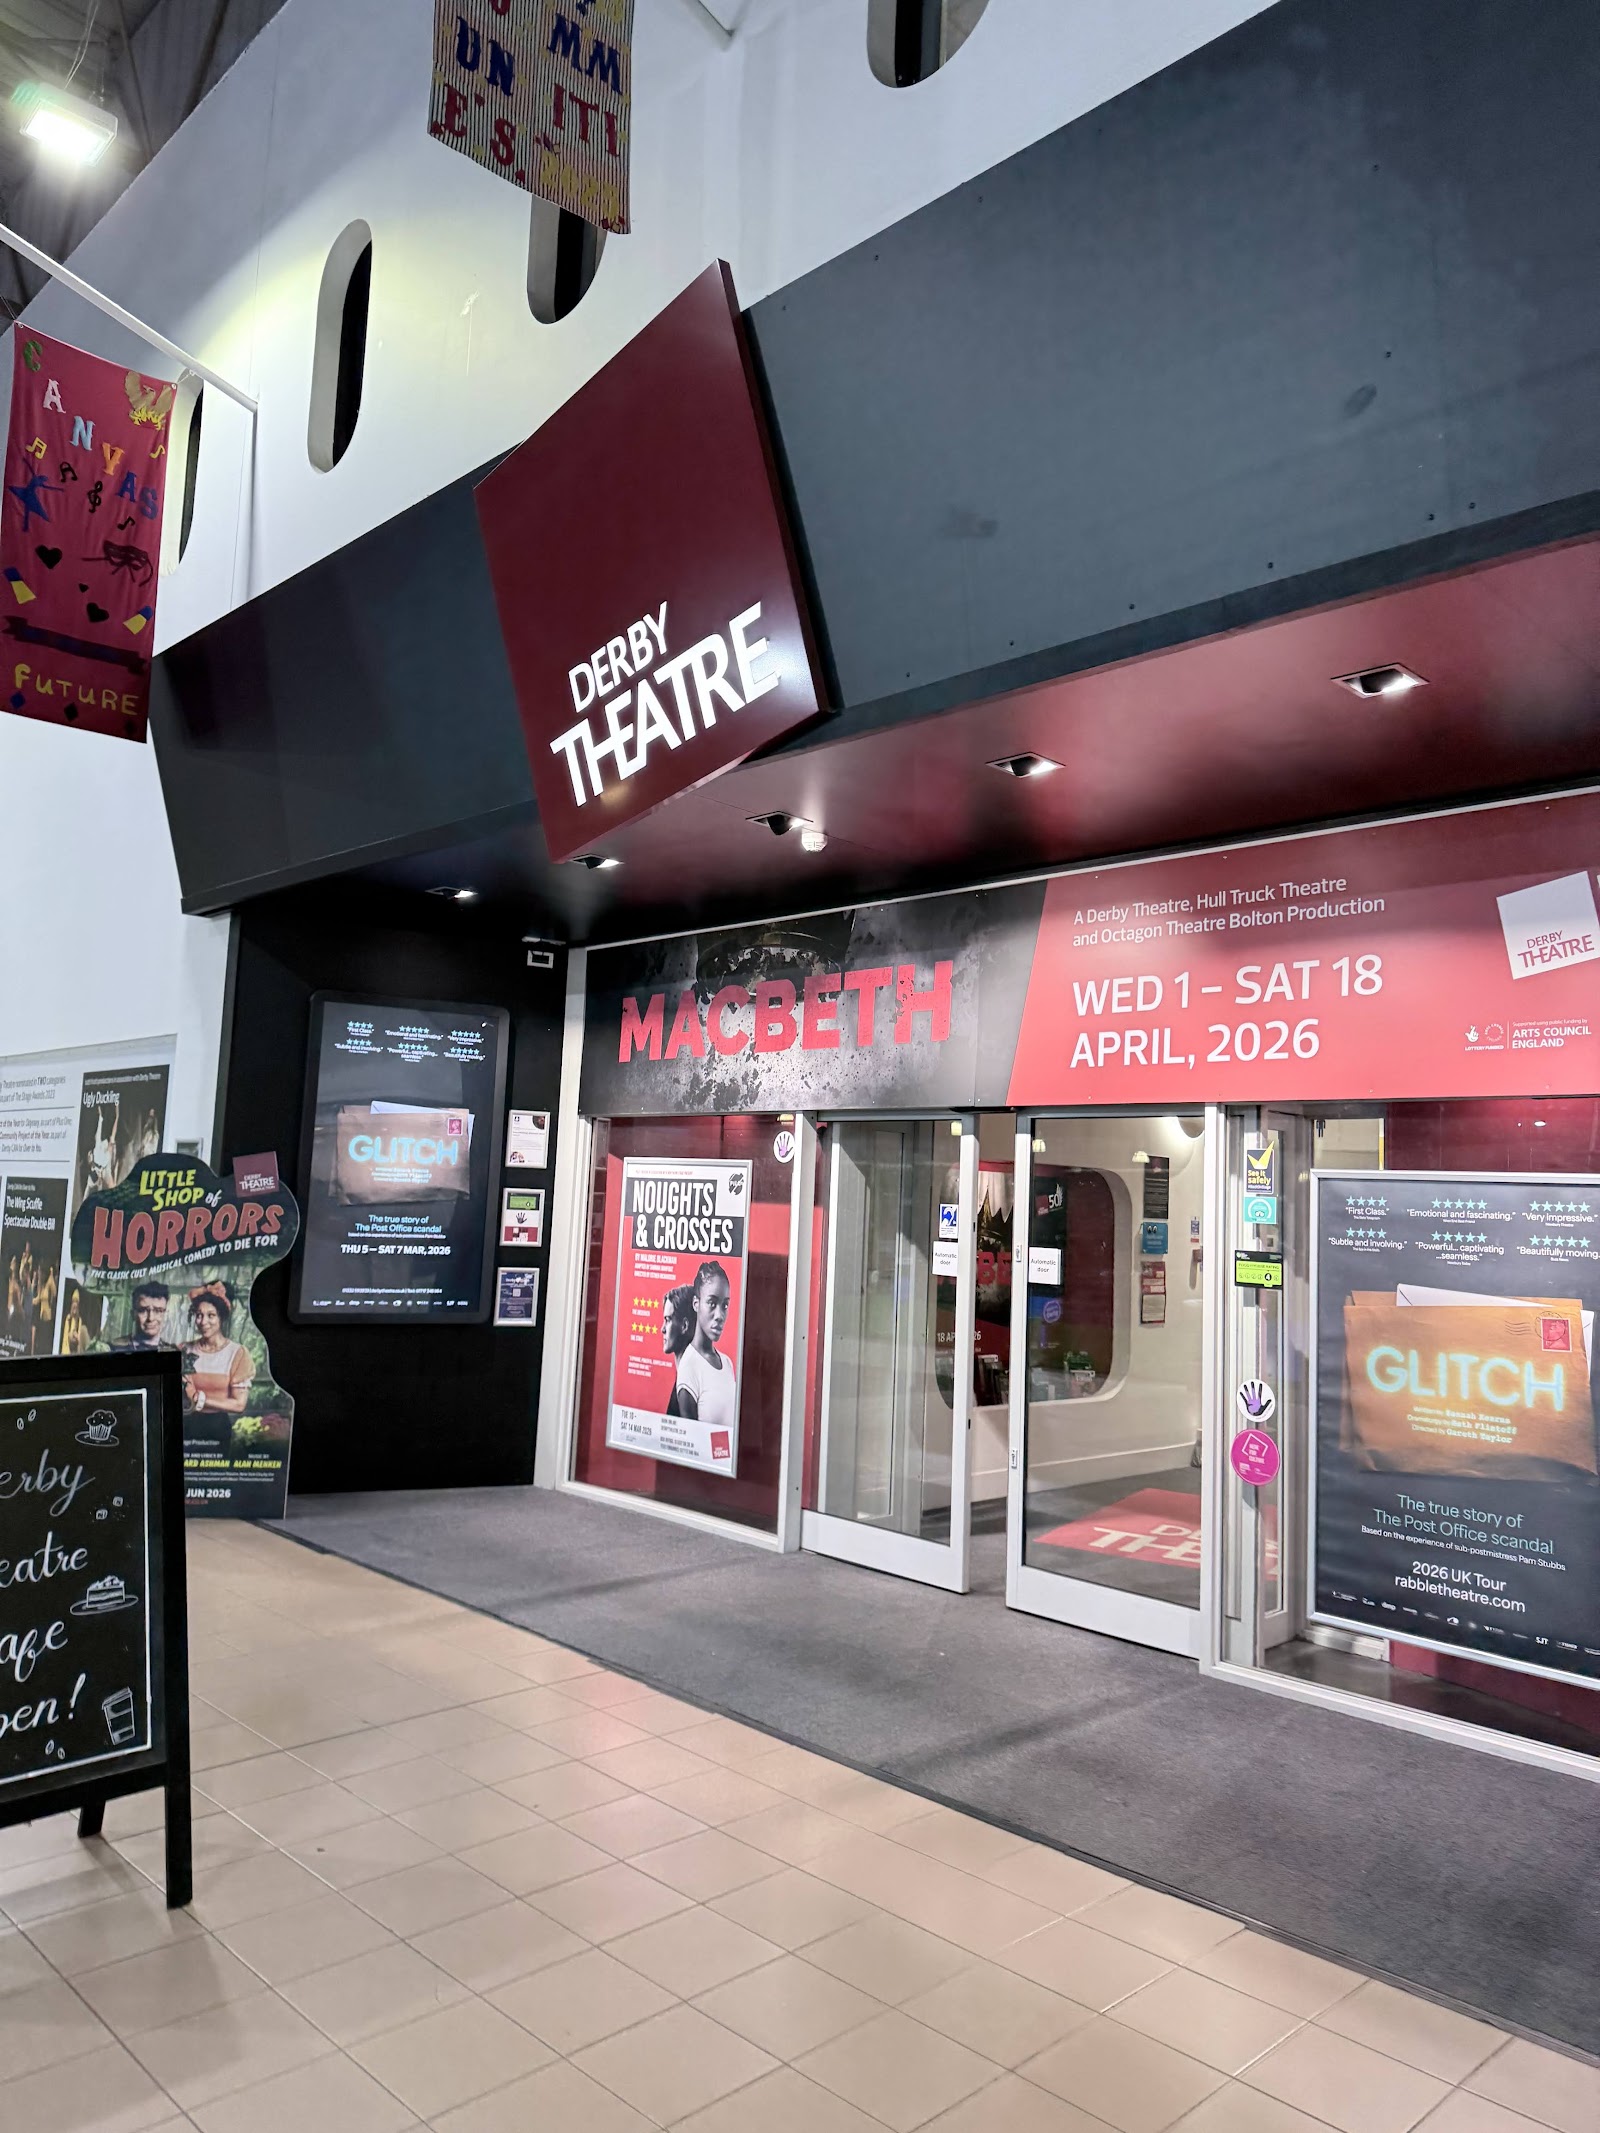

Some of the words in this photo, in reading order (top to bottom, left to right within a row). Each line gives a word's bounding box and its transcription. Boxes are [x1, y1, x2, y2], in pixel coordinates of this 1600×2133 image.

[568, 600, 667, 713] DERBY
[14, 663, 139, 716] FUTURE
[550, 600, 781, 807] THEATRE
[1073, 910, 1084, 926] A
[1087, 905, 1129, 924] Derby
[1132, 898, 1194, 919] Theatre,
[1196, 890, 1227, 910] Hull
[1230, 885, 1276, 905] Truck
[1279, 878, 1348, 899] Theatre
[1073, 931, 1098, 947] and
[1101, 925, 1162, 944] Octagon
[1166, 917, 1227, 936] Theatre
[1229, 910, 1283, 929] Bolton
[1287, 897, 1385, 922] Production
[1527, 930, 1563, 949] DERBY
[1517, 934, 1595, 968] THEATRE
[1072, 975, 1164, 1017] WED
[1174, 971, 1189, 1009] 1
[1235, 959, 1320, 1005] SAT
[1332, 954, 1383, 997] 18
[618, 959, 954, 1063] MACBETH
[1512, 1020, 1536, 1028] Supported
[1549, 1018, 1563, 1026] public
[1512, 1028, 1541, 1039] ARTS
[1543, 1026, 1592, 1037] COUNCIL
[1069, 1027, 1195, 1070] APRIL,
[1206, 1018, 1320, 1062] 2026
[1512, 1038, 1565, 1049] ENGLAND
[83, 1091, 95, 1108] Ugly
[96, 1090, 120, 1106] Duckling
[348, 1134, 459, 1166] GLITCH
[139, 1169, 197, 1196] LITTLE
[1248, 1169, 1259, 1177] See
[1248, 1175, 1272, 1186] safely
[239, 1177, 276, 1190] THEATRE
[6, 1195, 14, 1208] The
[152, 1187, 205, 1212] SHOP
[205, 1189, 223, 1208] of
[633, 1180, 714, 1217] NOUGHTS
[4, 1213, 31, 1228] Spectacular
[31, 1215, 48, 1230] Double
[368, 1214, 383, 1223] The
[384, 1215, 400, 1223] true
[401, 1216, 420, 1225] story
[421, 1215, 430, 1224] of
[1450, 1210, 1466, 1218] and
[91, 1202, 285, 1270] HORRORS
[355, 1223, 370, 1232] The
[371, 1224, 388, 1232] Post
[389, 1223, 412, 1233] Office
[413, 1225, 442, 1234] scandal
[636, 1214, 648, 1248] &
[654, 1215, 733, 1254] CROSSES
[340, 1244, 361, 1255] THU
[362, 1244, 369, 1254] 5
[378, 1245, 396, 1255] SAT
[397, 1245, 403, 1255] 7
[403, 1246, 427, 1256] MAR,
[428, 1246, 451, 1256] 2026
[1354, 1239, 1369, 1247] and
[1460, 1245, 1505, 1256] captivating
[91, 1270, 107, 1280] THE
[107, 1270, 130, 1280] CLASSIC
[130, 1267, 147, 1280] CULT
[149, 1260, 183, 1276] MUSICAL
[184, 1246, 217, 1265] COMEDY
[219, 1243, 232, 1254] TO
[234, 1238, 251, 1251] DIE
[255, 1235, 278, 1247] FOR
[934, 1252, 957, 1260] Automatic
[1030, 1258, 1057, 1267] Automatic
[1366, 1346, 1564, 1412] GLITCH
[633, 1424, 642, 1434] MAR
[1446, 1428, 1477, 1439] Gareth
[200, 1460, 230, 1468] ASHMAN
[234, 1460, 252, 1468] ALAN
[253, 1460, 282, 1469] MENKEN
[186, 1488, 205, 1498] JUN
[206, 1488, 231, 1499] 2026
[1396, 1493, 1425, 1512] The
[1429, 1500, 1460, 1518] true
[1463, 1508, 1502, 1529] story
[1506, 1514, 1525, 1529] of
[1372, 1508, 1402, 1526] The
[1404, 1515, 1438, 1535] Post
[1440, 1521, 1488, 1543] Office
[1491, 1533, 1554, 1555] scandal
[1361, 1525, 1382, 1536] Based
[1383, 1531, 1393, 1539] on
[1393, 1531, 1405, 1541] the
[1405, 1535, 1445, 1549] experience
[1445, 1541, 1453, 1550] of
[1454, 1544, 1518, 1562] sub-postmistress
[1519, 1555, 1536, 1566] Pam
[1538, 1558, 1566, 1572] Stubbs
[1412, 1561, 1449, 1580] 2026
[1451, 1568, 1472, 1585] UK
[1473, 1572, 1507, 1591] Tour
[1394, 1575, 1526, 1613] rabbletheatre.com
